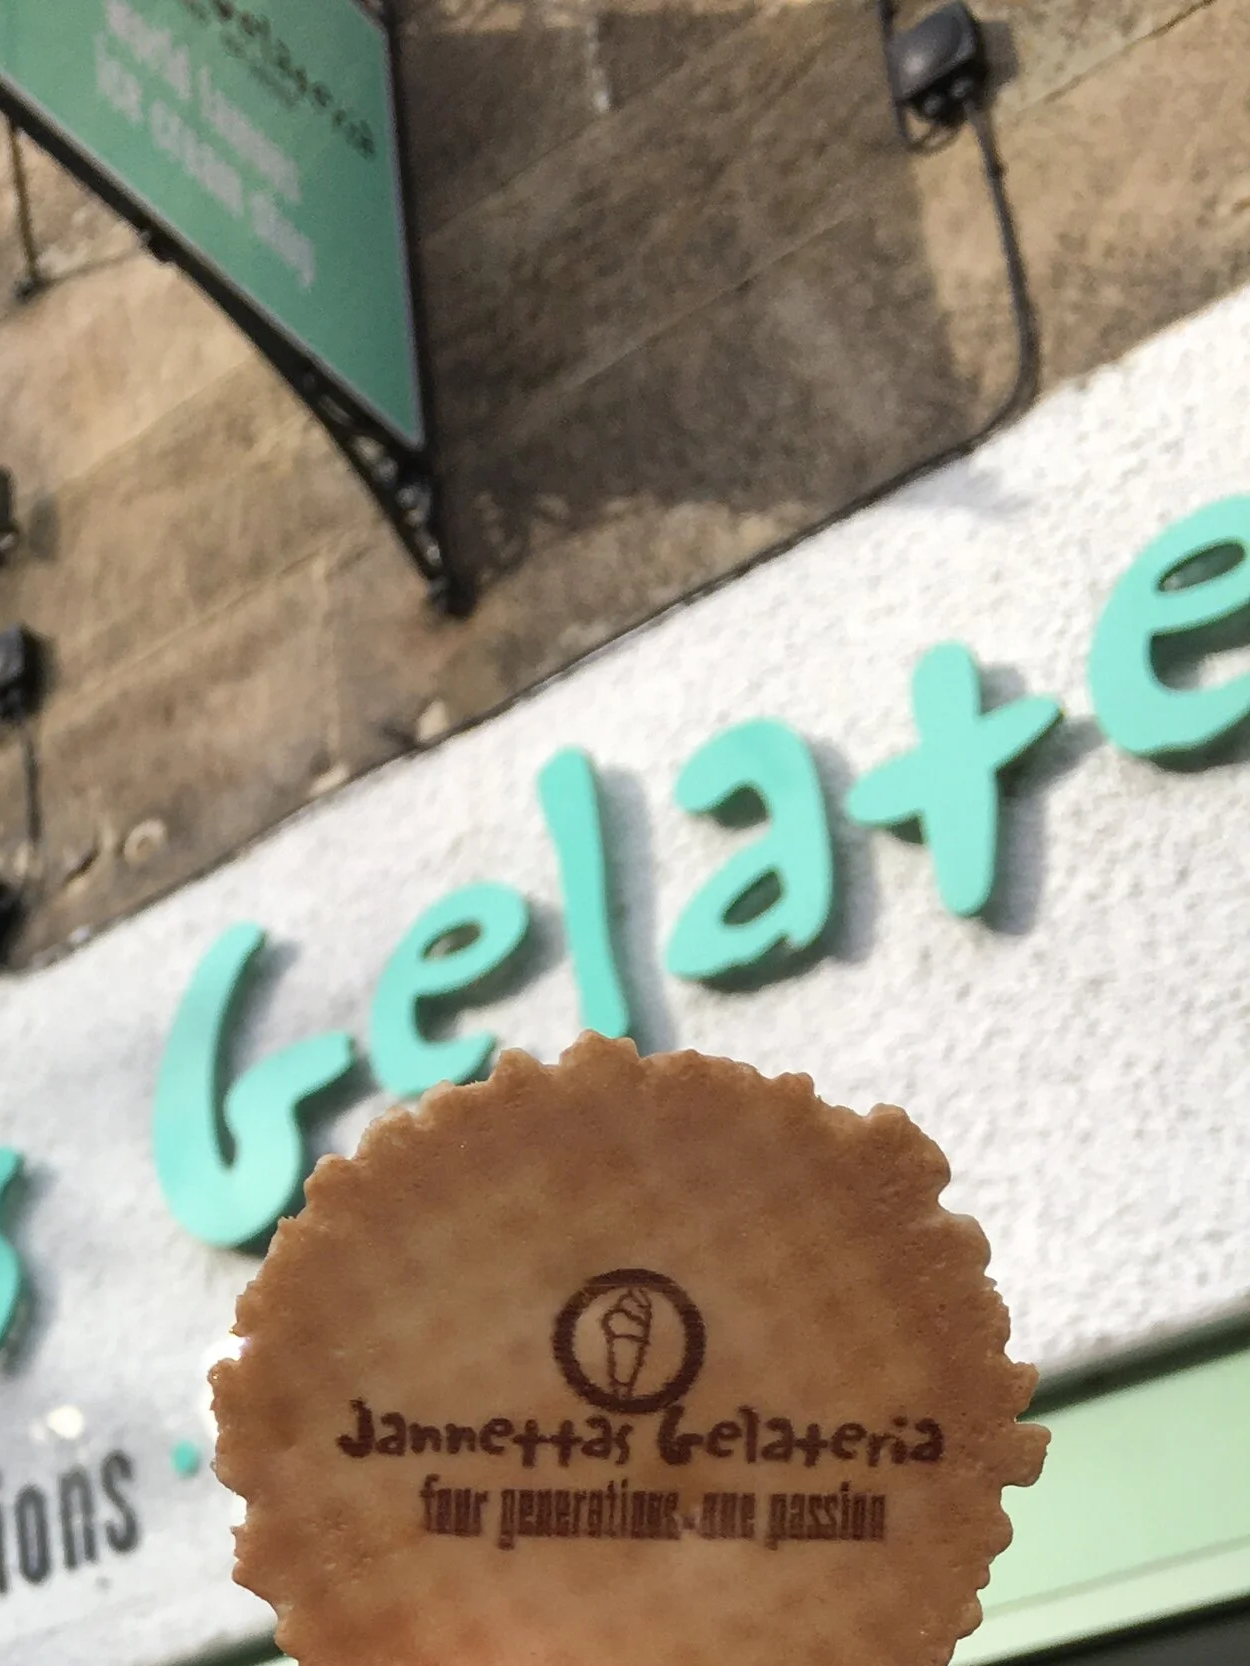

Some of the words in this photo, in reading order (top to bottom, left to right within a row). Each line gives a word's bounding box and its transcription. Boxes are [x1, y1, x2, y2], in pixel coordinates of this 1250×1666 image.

[338, 1399, 633, 1467] Jannettas
[657, 1404, 945, 1467] Gelateria
[419, 1473, 489, 1537] four
[766, 1481, 887, 1550] passion
